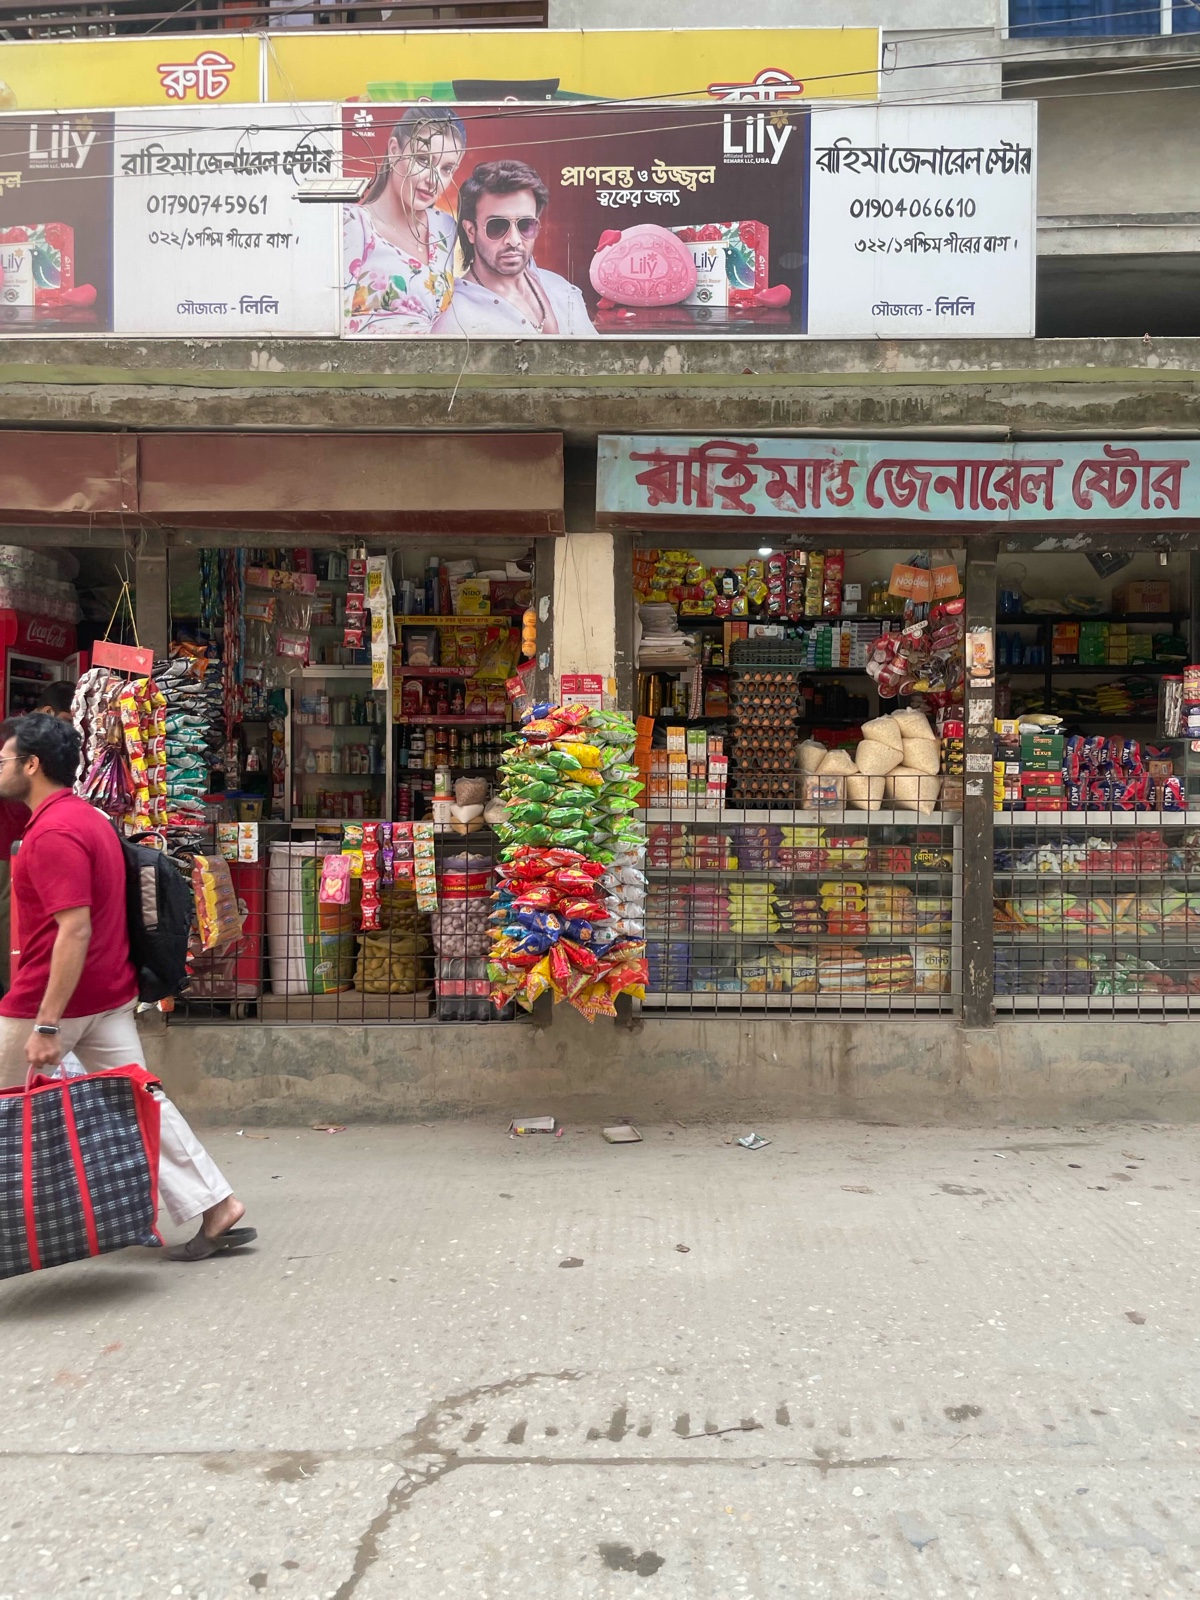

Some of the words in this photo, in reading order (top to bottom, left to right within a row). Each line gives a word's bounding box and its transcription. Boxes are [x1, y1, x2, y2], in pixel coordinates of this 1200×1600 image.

[157, 51, 235, 100] রুচি
[29, 121, 97, 169] Lily
[723, 113, 793, 165] Lily
[814, 137, 889, 174] রাহিমা
[889, 145, 985, 176] জেনারেল
[560, 166, 635, 189] প্রাণবন্ত
[637, 170, 649, 182] ও
[651, 159, 716, 191] উজ্জ্বল
[146, 194, 268, 217] 01790745961
[596, 190, 642, 208] ত্বকের
[643, 190, 681, 207] জন্য
[850, 197, 976, 219] 01904066610
[176, 299, 227, 315] সৌজন্যে
[239, 295, 279, 315] লিলি
[871, 300, 923, 316] সৌজন্যে
[935, 296, 976, 316] লিলি
[866, 458, 1064, 513] জেনারেল
[895, 575, 929, 588] Noodles
